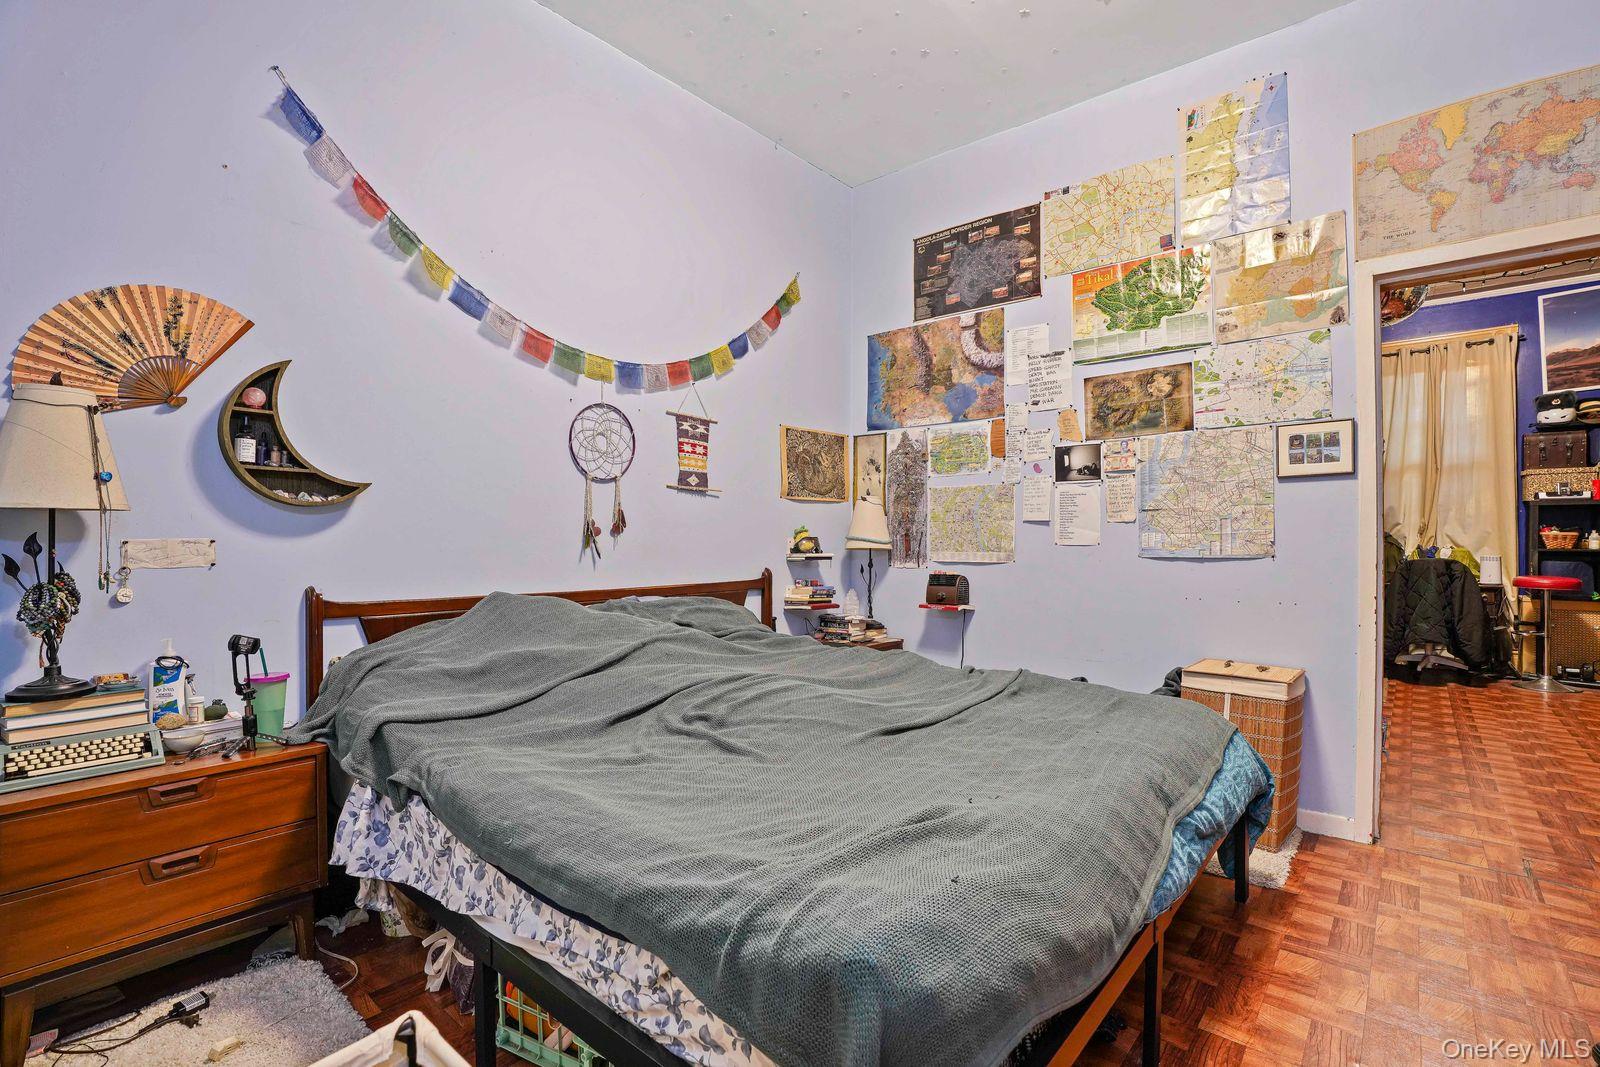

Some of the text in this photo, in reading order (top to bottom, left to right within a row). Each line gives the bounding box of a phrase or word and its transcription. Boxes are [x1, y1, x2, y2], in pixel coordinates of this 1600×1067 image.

[951, 223, 973, 234] BORDER
[972, 217, 993, 228] REGION
[1396, 230, 1417, 238] WORLD
[1085, 269, 1114, 285] Tikal
